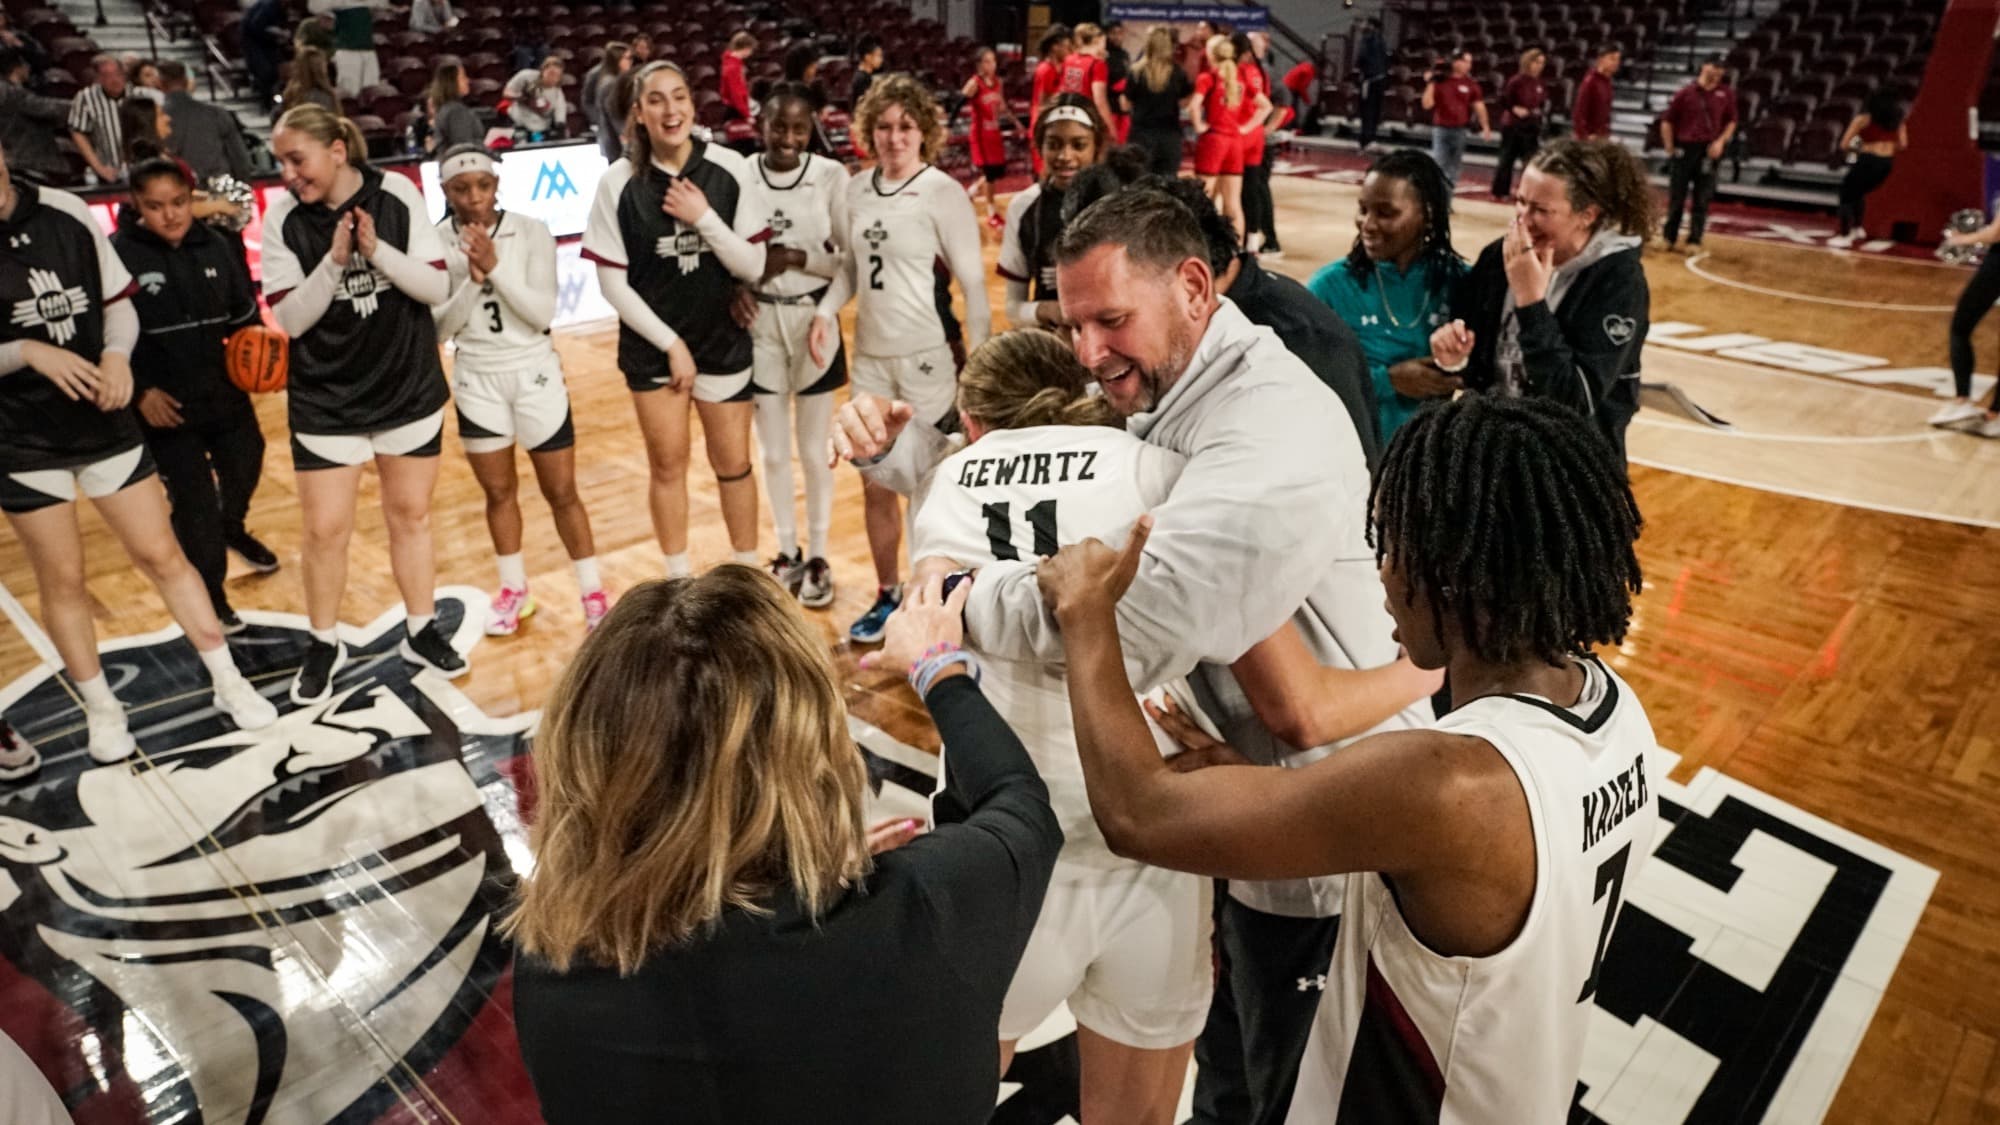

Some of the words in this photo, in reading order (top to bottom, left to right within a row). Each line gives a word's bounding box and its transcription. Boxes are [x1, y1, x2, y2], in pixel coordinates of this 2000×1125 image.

[869, 255, 884, 290] 2
[483, 301, 503, 333] 3
[958, 451, 1099, 488] GEWIRTZ
[982, 499, 1059, 562] 11
[1576, 839, 1632, 1004] 7
